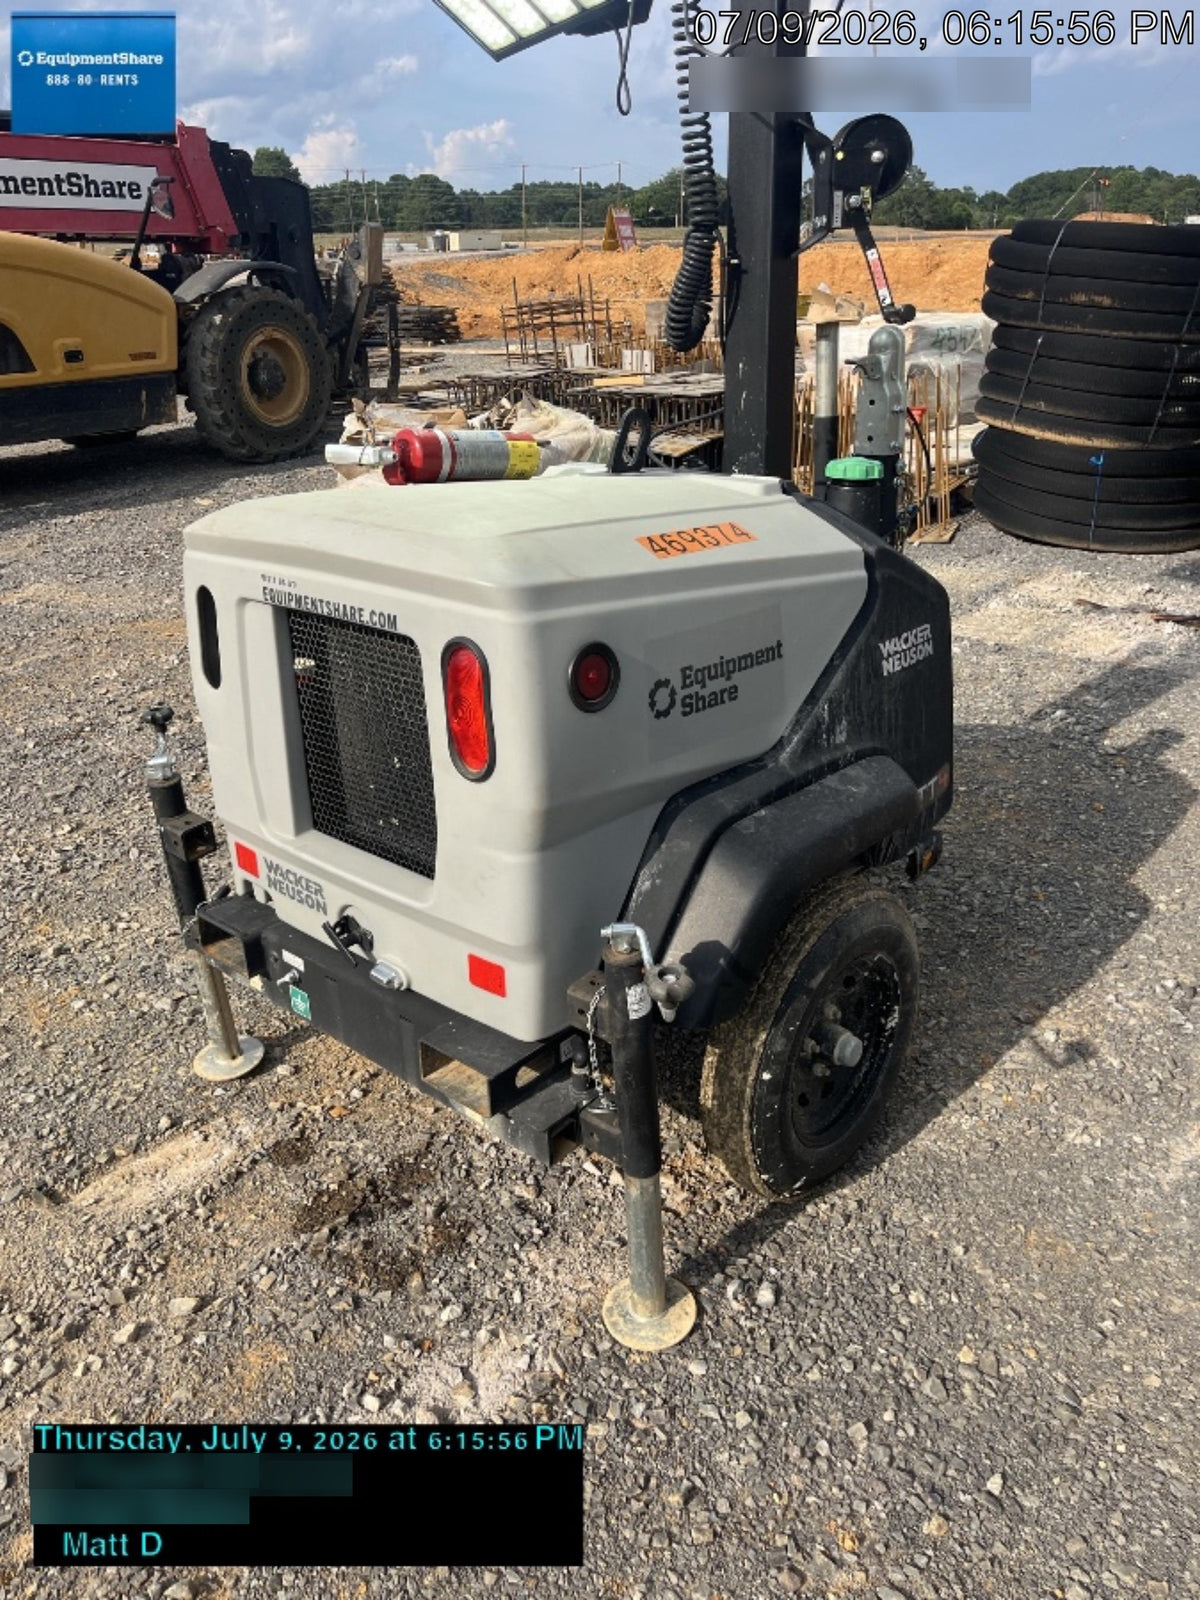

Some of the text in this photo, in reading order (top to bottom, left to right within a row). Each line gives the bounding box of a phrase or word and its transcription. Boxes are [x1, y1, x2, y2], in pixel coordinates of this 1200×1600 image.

[646, 522, 752, 555] 469374
[262, 586, 398, 631] EQUIPMENTSHARE.COM
[878, 623, 933, 658] WACKER
[881, 640, 934, 677] NEUSON
[680, 640, 784, 690] Equipment
[680, 684, 739, 717] Share
[263, 856, 326, 901] WACKER
[266, 873, 328, 917] NEUSON
